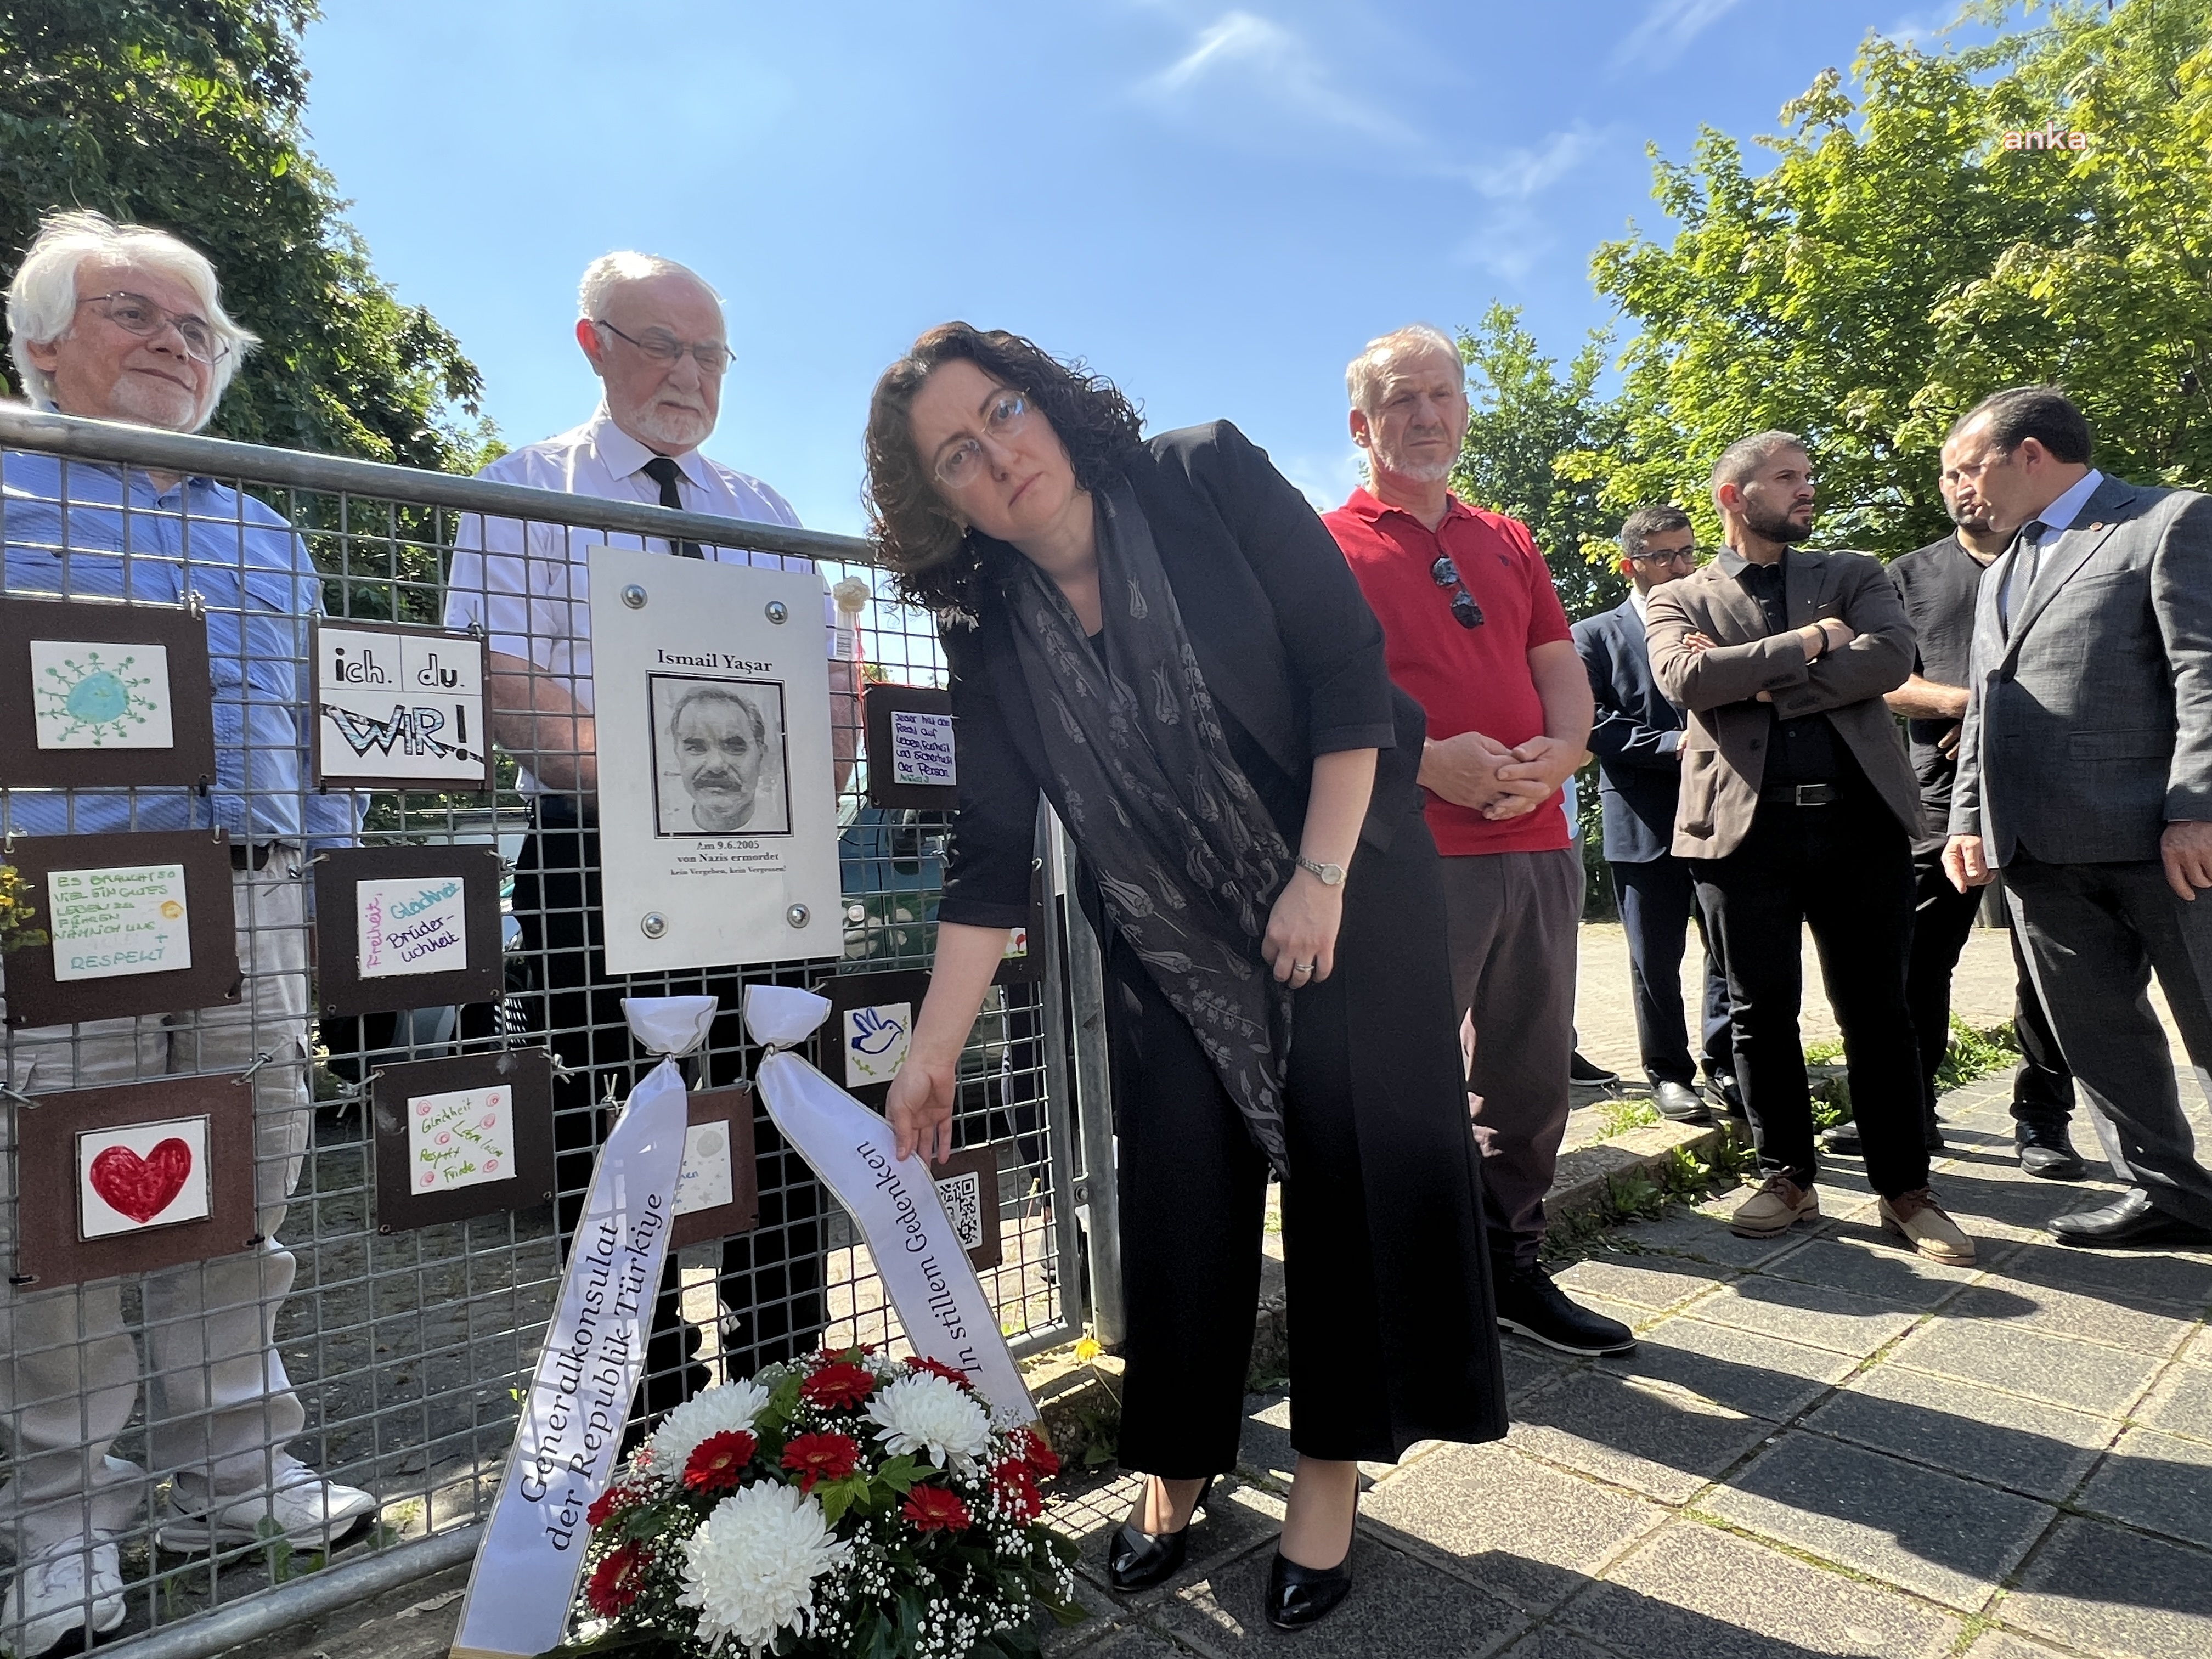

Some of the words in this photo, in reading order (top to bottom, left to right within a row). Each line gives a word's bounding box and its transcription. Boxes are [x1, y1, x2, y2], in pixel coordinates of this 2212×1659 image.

[657, 649, 718, 667] Ismail
[722, 654, 772, 674] Yaşar
[326, 704, 468, 760] WIR!
[697, 842, 715, 850] Am
[718, 840, 759, 850] 9.6.2005
[699, 853, 728, 862] Nazis
[731, 852, 779, 861] ermordet
[70, 947, 166, 969] RESPEKT
[856, 1139, 928, 1254] Gedenken
[920, 1255, 969, 1341] stillem
[520, 1221, 618, 1502] Generalkonsulat
[545, 1488, 583, 1551] der
[567, 1328, 633, 1481] Republik
[614, 1193, 663, 1317] Türkiye
[958, 1346, 983, 1374] In
